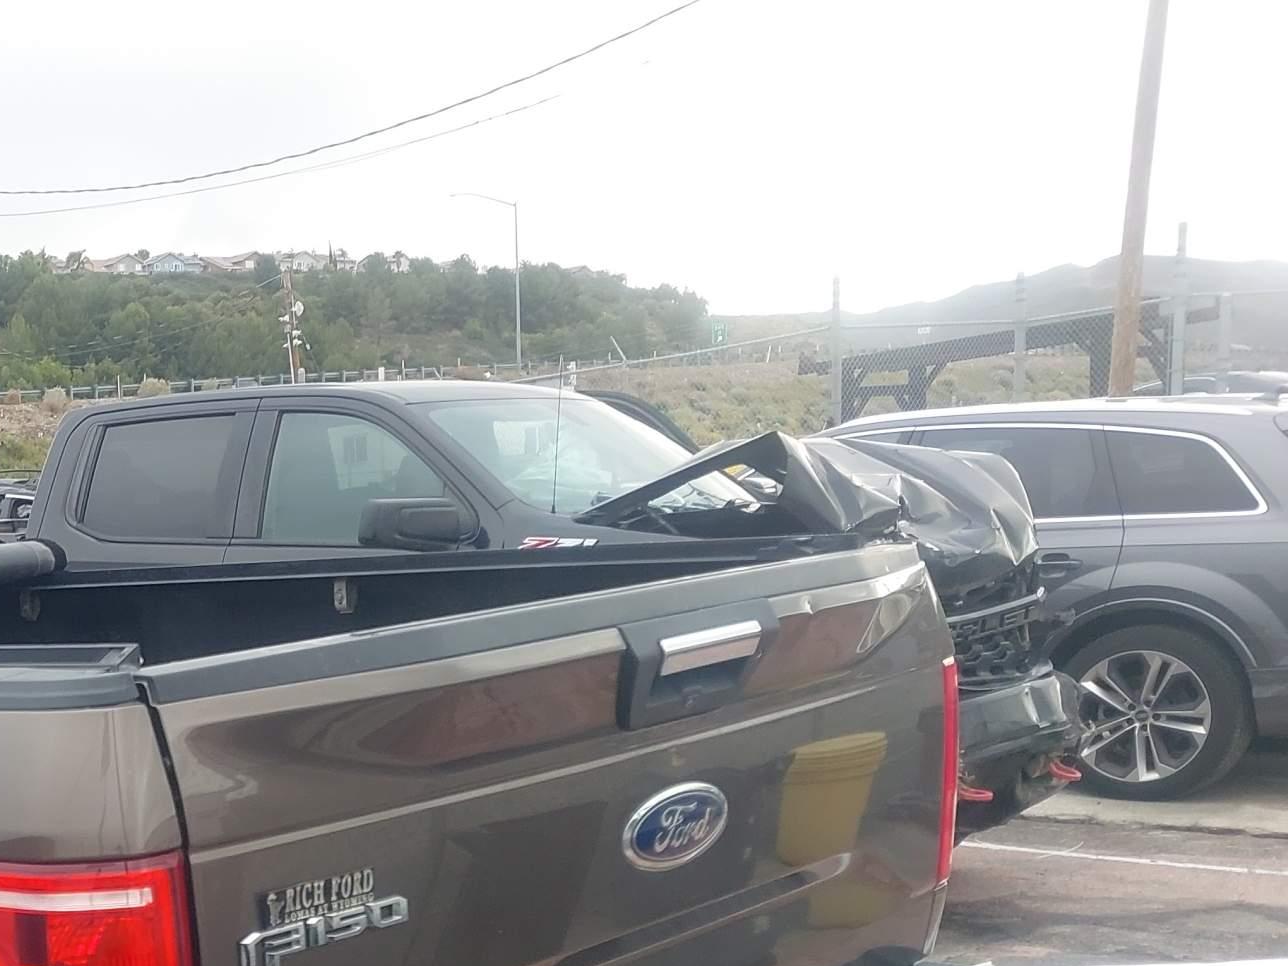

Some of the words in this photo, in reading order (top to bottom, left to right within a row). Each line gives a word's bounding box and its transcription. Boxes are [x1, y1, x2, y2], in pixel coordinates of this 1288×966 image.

[654, 801, 712, 853] Ford
[285, 880, 326, 913] RICH
[330, 868, 374, 902] FORD
